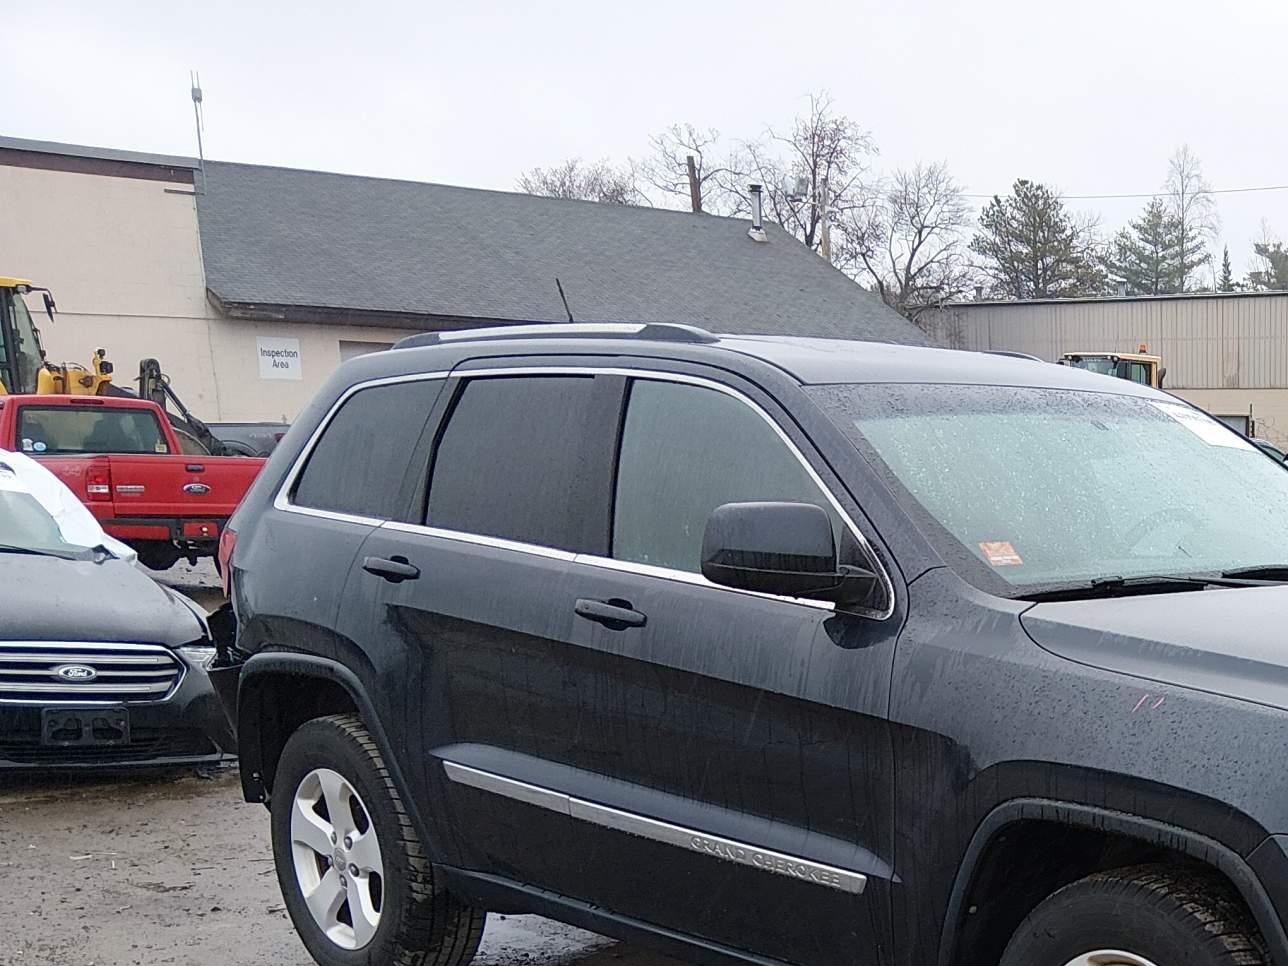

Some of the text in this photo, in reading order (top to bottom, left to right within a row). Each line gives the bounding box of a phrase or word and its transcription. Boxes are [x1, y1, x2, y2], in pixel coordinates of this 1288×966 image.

[260, 347, 298, 359] Inspection
[272, 359, 289, 369] Area
[690, 837, 842, 888] GRAND CHEROKEE
